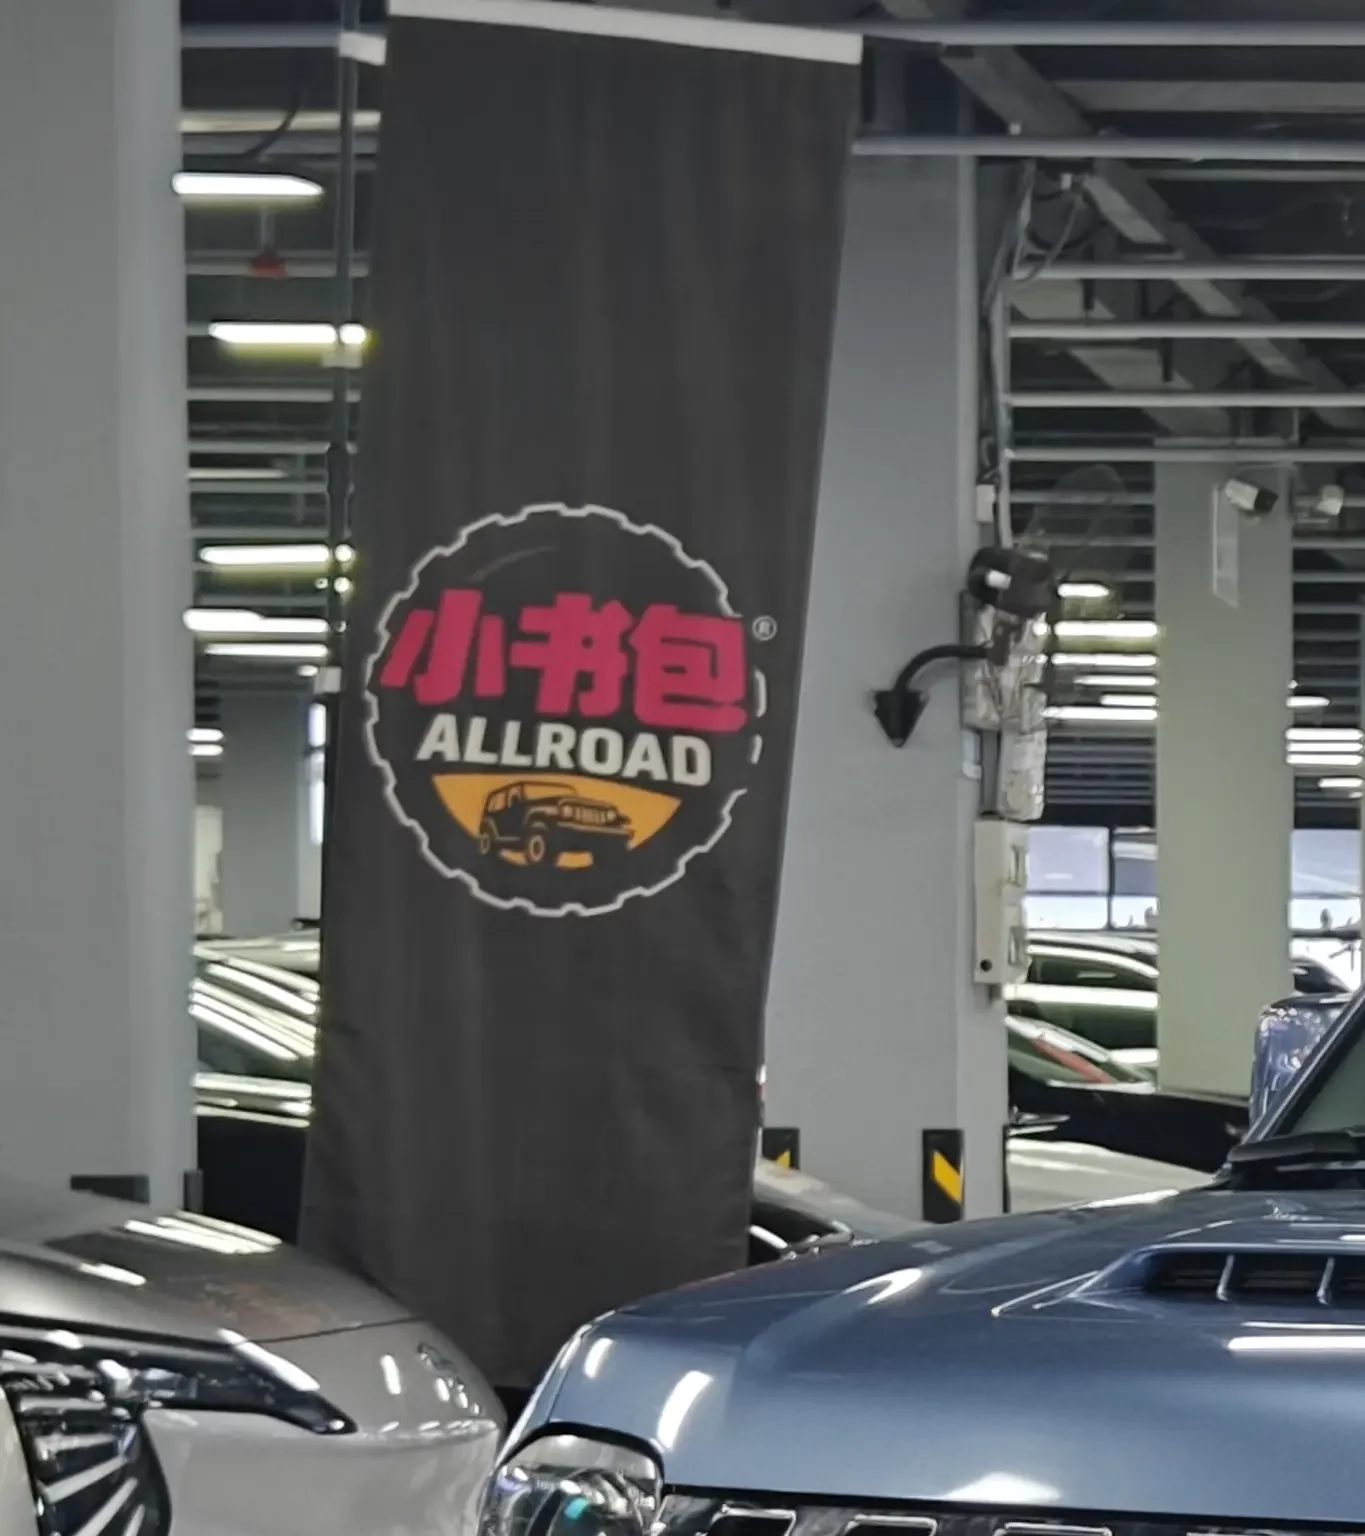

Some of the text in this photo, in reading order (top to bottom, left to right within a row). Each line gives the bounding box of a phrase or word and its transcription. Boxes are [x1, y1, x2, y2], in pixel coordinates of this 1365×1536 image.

[380, 589, 747, 732] 小书包
[415, 713, 712, 787] ALLROAD
